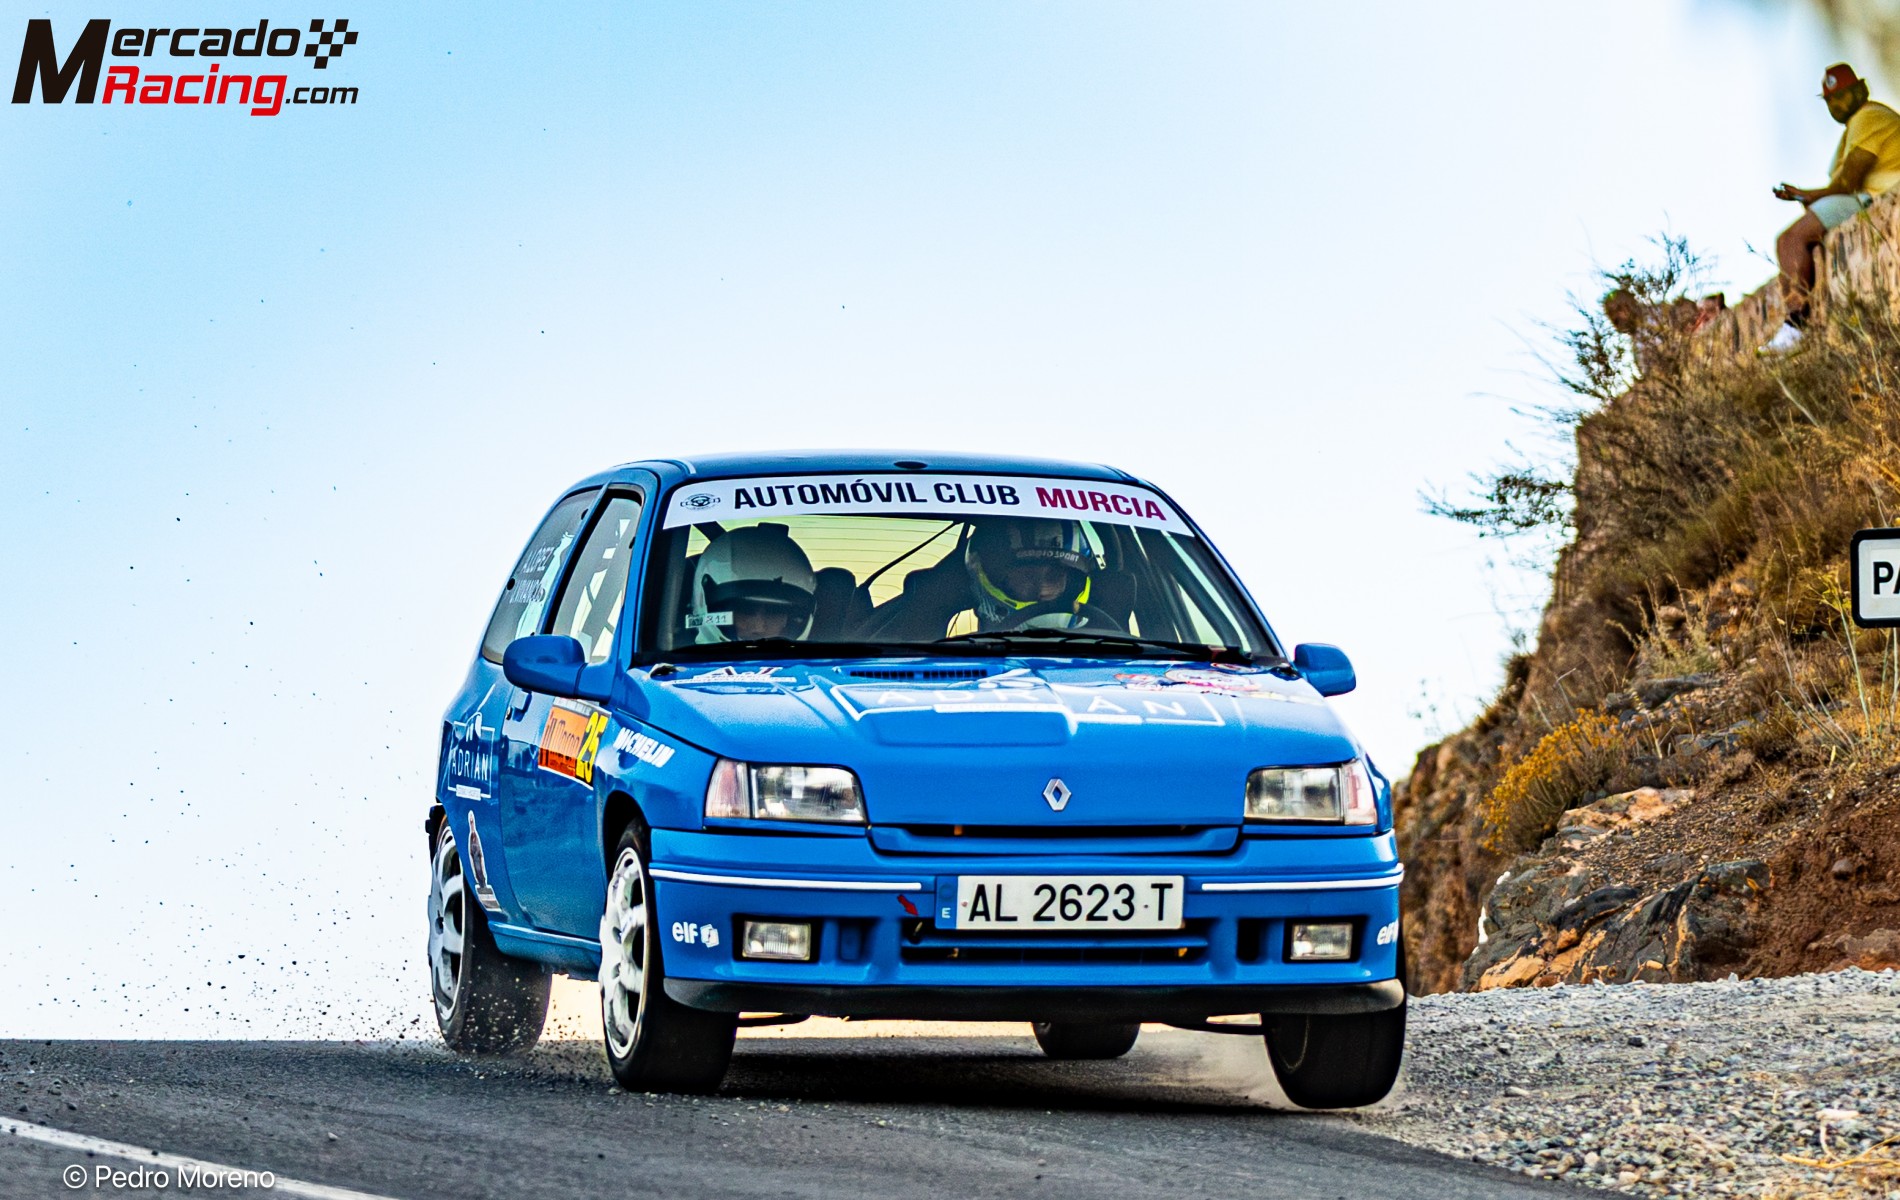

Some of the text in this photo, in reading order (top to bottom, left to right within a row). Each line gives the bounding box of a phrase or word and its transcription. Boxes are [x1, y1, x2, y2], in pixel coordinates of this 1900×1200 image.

[733, 479, 928, 510] AUTOMÓVIL
[933, 482, 1020, 506] CLUB
[1035, 486, 1168, 522] MURCIA
[576, 711, 609, 784] 25
[613, 727, 676, 768] MICHELIN
[941, 907, 951, 919] E
[968, 883, 1174, 922] AL 2623 T
[672, 921, 699, 945] elf
